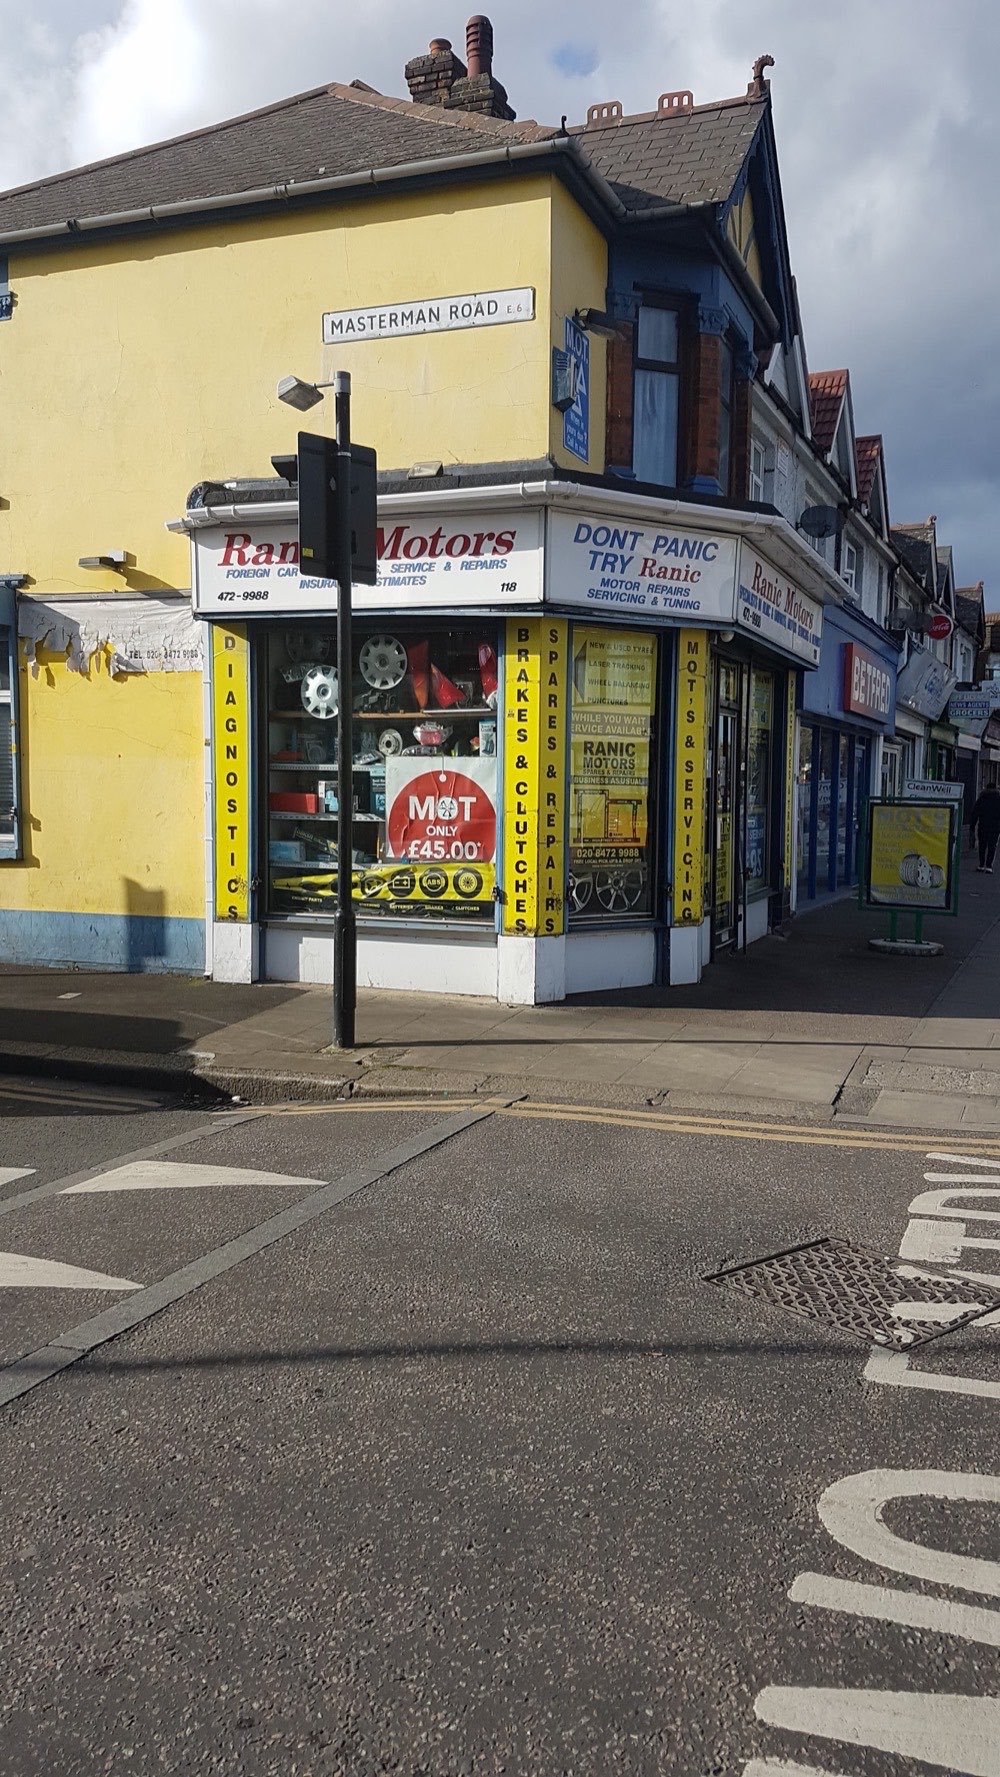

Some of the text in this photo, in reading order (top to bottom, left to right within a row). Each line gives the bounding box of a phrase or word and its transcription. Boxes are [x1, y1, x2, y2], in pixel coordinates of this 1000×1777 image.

[330, 307, 440, 336] MASTERMAN
[449, 300, 499, 320] ROAD
[218, 533, 299, 567] Ran
[573, 523, 719, 562] DONT PANIC
[226, 567, 270, 579] FOREIGN
[277, 566, 299, 578] CAR
[390, 561, 436, 574] SERVICE
[443, 560, 452, 572] &
[460, 558, 508, 571] REPAIRS
[588, 550, 702, 584] TRY Ranic
[217, 582, 517, 602] 472-9988 118
[299, 575, 427, 589] INSURA STIMATES
[600, 577, 690, 597] MOTOR REPAIRS
[587, 588, 701, 611] SERVICING & TUNING
[751, 561, 782, 607] Ranic
[784, 587, 814, 630] Motors
[589, 641, 605, 650] NEW
[613, 643, 631, 652] USED
[633, 646, 654, 655] TYRES
[588, 660, 645, 671] LASER TRACKING
[588, 678, 650, 689] WHEEL BALANCING
[853, 655, 891, 714] BETFRED
[587, 696, 628, 706] PUNCTURES
[571, 723, 603, 734] ERVICE
[572, 712, 646, 725] WHILE YOU WAIT
[583, 740, 636, 757] RANIC
[583, 757, 636, 770] MOTORS
[224, 636, 238, 919] DIAGNOSTICS
[515, 628, 530, 933] BRAKES & CLUTCHES
[545, 629, 559, 932] SPARES & REPAIRS
[573, 776, 609, 785] BUSINESS
[682, 641, 699, 920] MOT'S & SERVICING
[907, 782, 952, 795] CleanWell
[408, 796, 477, 821] MOT
[426, 825, 459, 837] ONLY
[576, 848, 639, 858] 020 8472 9988
